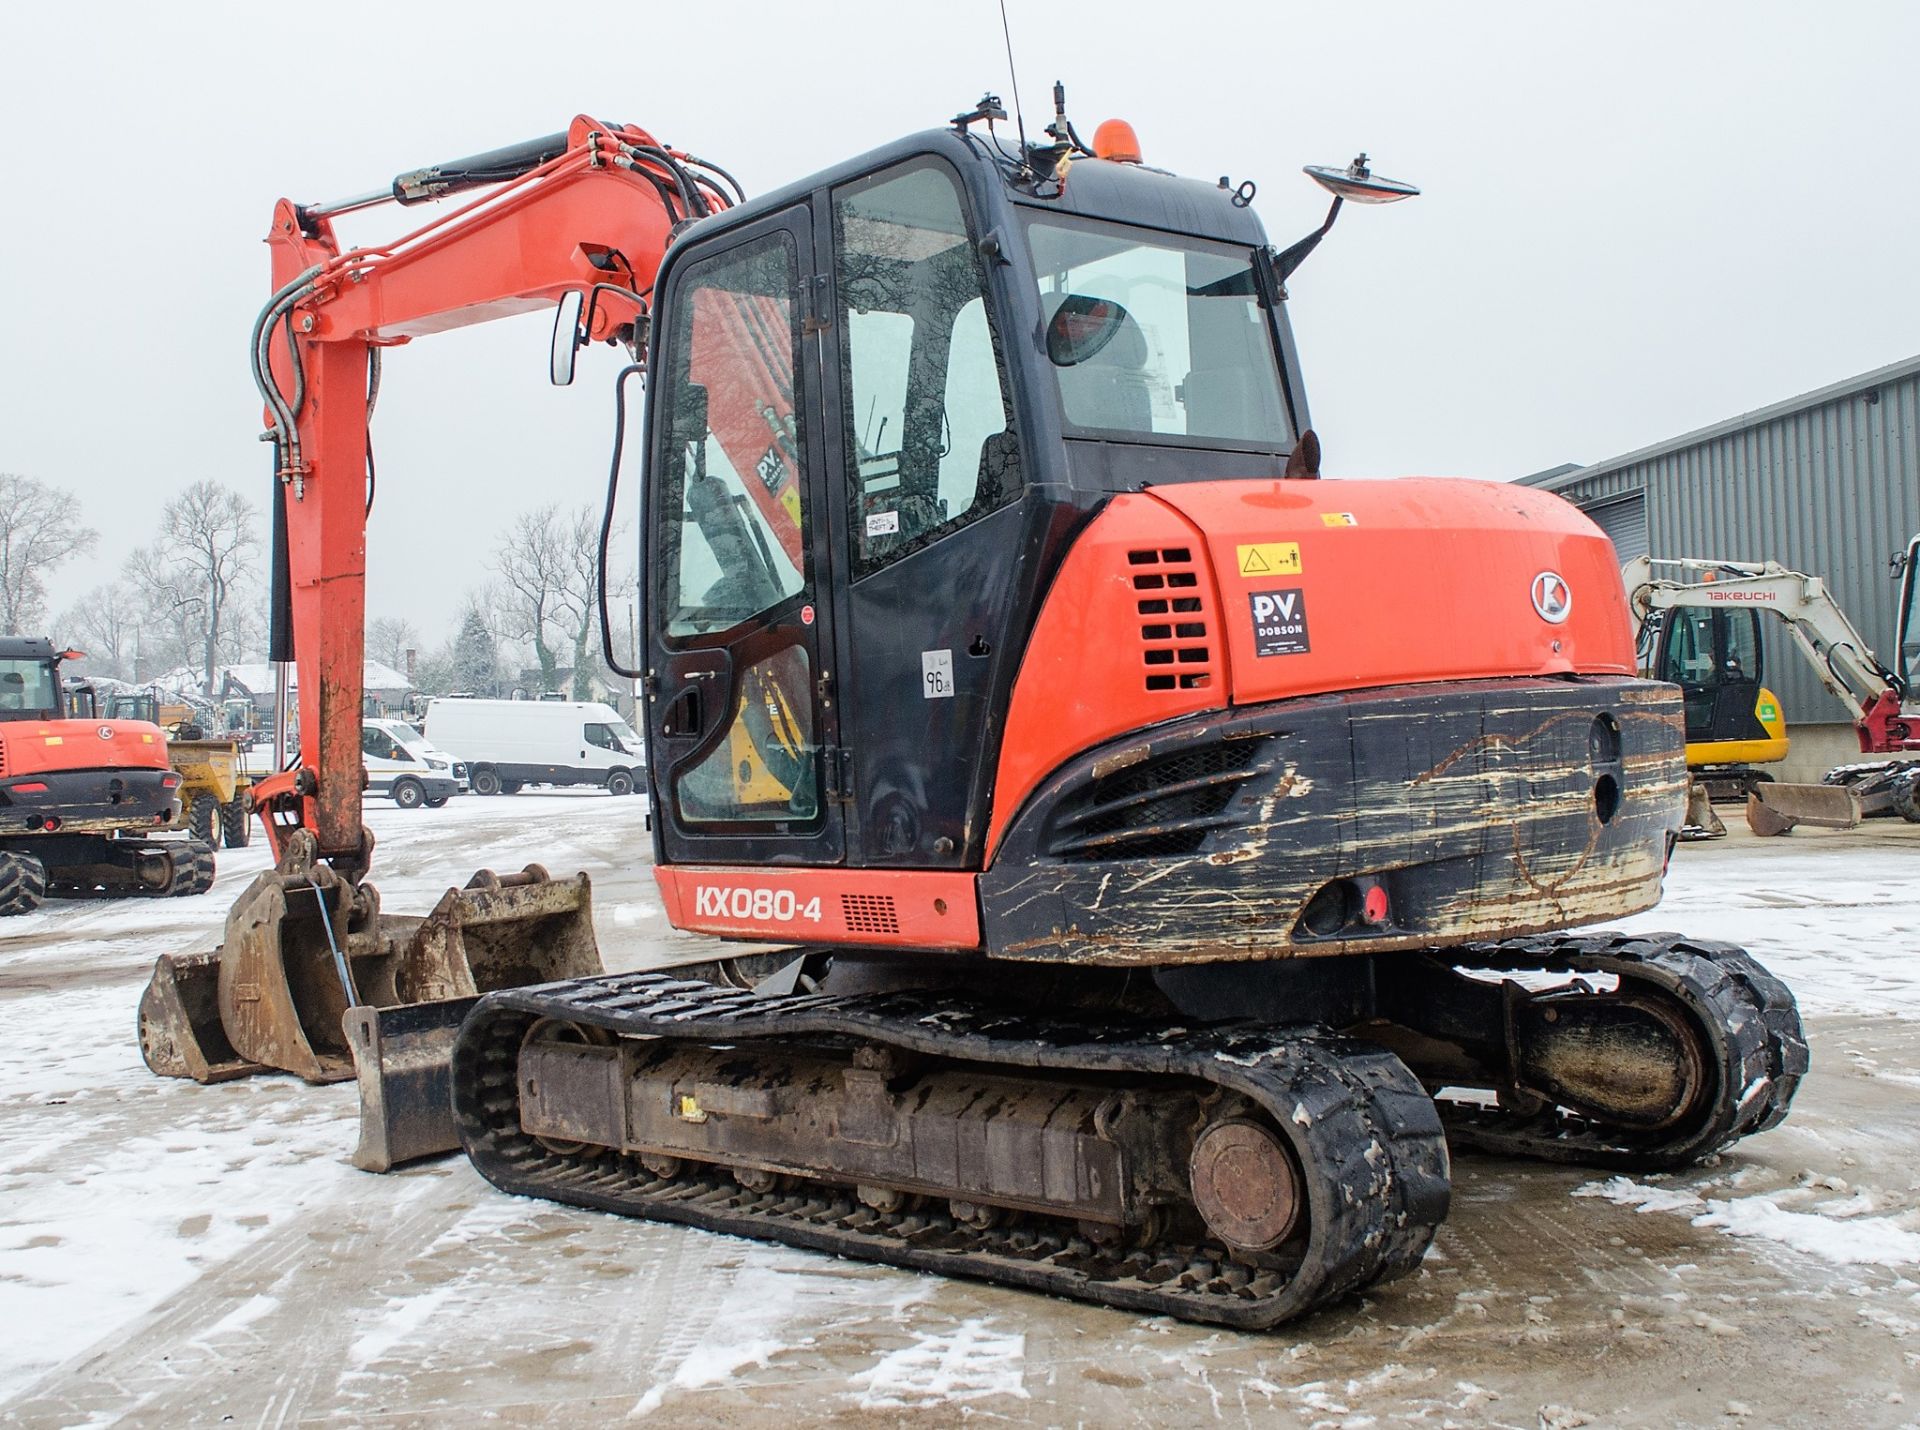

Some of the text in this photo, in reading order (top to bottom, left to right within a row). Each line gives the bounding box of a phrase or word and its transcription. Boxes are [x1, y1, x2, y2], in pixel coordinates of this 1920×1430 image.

[1706, 591, 1776, 601] TAKEUCHI
[1253, 593, 1301, 624] P.V.
[1258, 625, 1303, 637] DOBSON
[926, 671, 943, 693] 96
[695, 885, 822, 922] KX080-4
